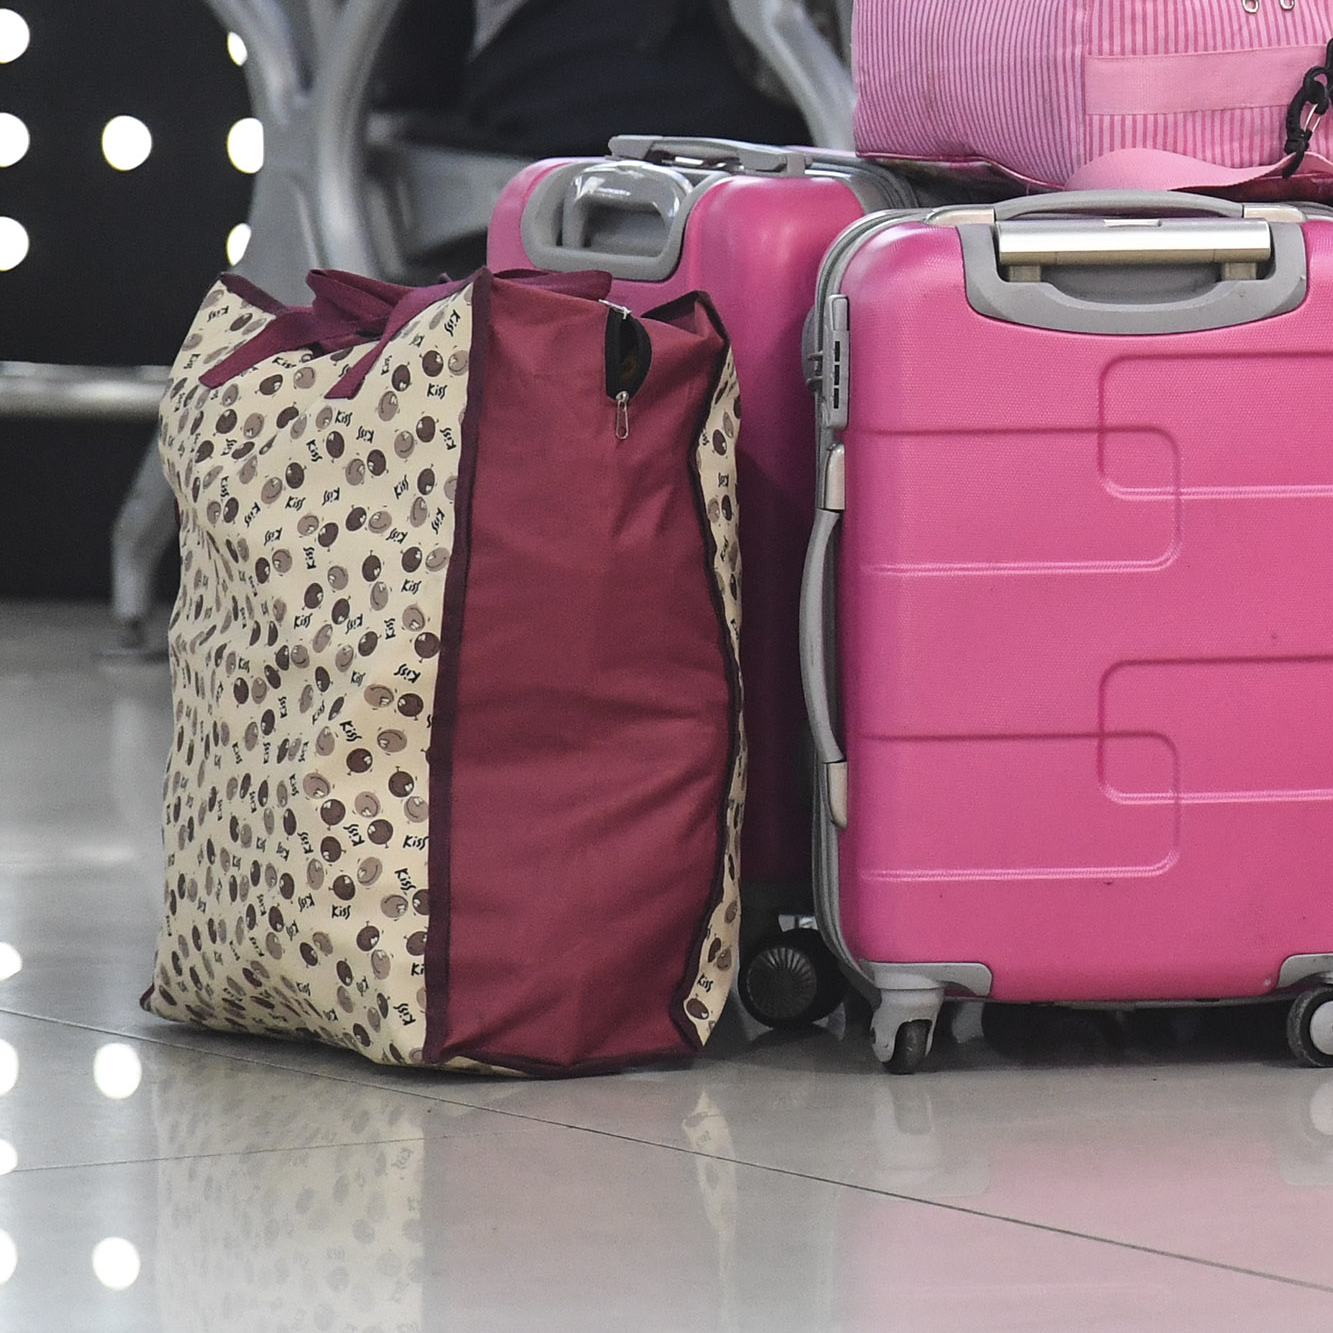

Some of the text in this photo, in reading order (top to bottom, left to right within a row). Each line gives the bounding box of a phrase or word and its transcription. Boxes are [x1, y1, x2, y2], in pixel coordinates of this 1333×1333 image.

[444, 309, 461, 337] Kiss
[427, 383, 448, 399] Kiss
[335, 410, 353, 426] Kiss
[356, 426, 374, 443] Kiss
[440, 427, 457, 450] Kiss
[306, 439, 323, 462] Kiss
[322, 487, 340, 506] Kiss
[393, 474, 410, 500] Kiss
[285, 496, 306, 511] Kiss
[244, 502, 261, 528] Kiss
[431, 507, 446, 535] Kiss
[263, 527, 283, 546] Kiss
[385, 528, 408, 544] Kiss
[303, 546, 316, 569] Kiss
[401, 579, 422, 595] Kiss
[294, 612, 313, 630] Kiss
[345, 613, 363, 634] Kiss
[384, 618, 396, 640] Kiss
[393, 664, 421, 684] Kiss
[339, 720, 362, 742] Kiss
[297, 832, 315, 854] Kiss
[343, 824, 365, 847] Kiss
[403, 835, 429, 850] Kiss
[394, 868, 417, 891] Kiss
[331, 905, 351, 920] Kiss
[411, 962, 425, 976] Ki
[697, 973, 713, 993] Kiss
[393, 1003, 416, 1026] Kiss
